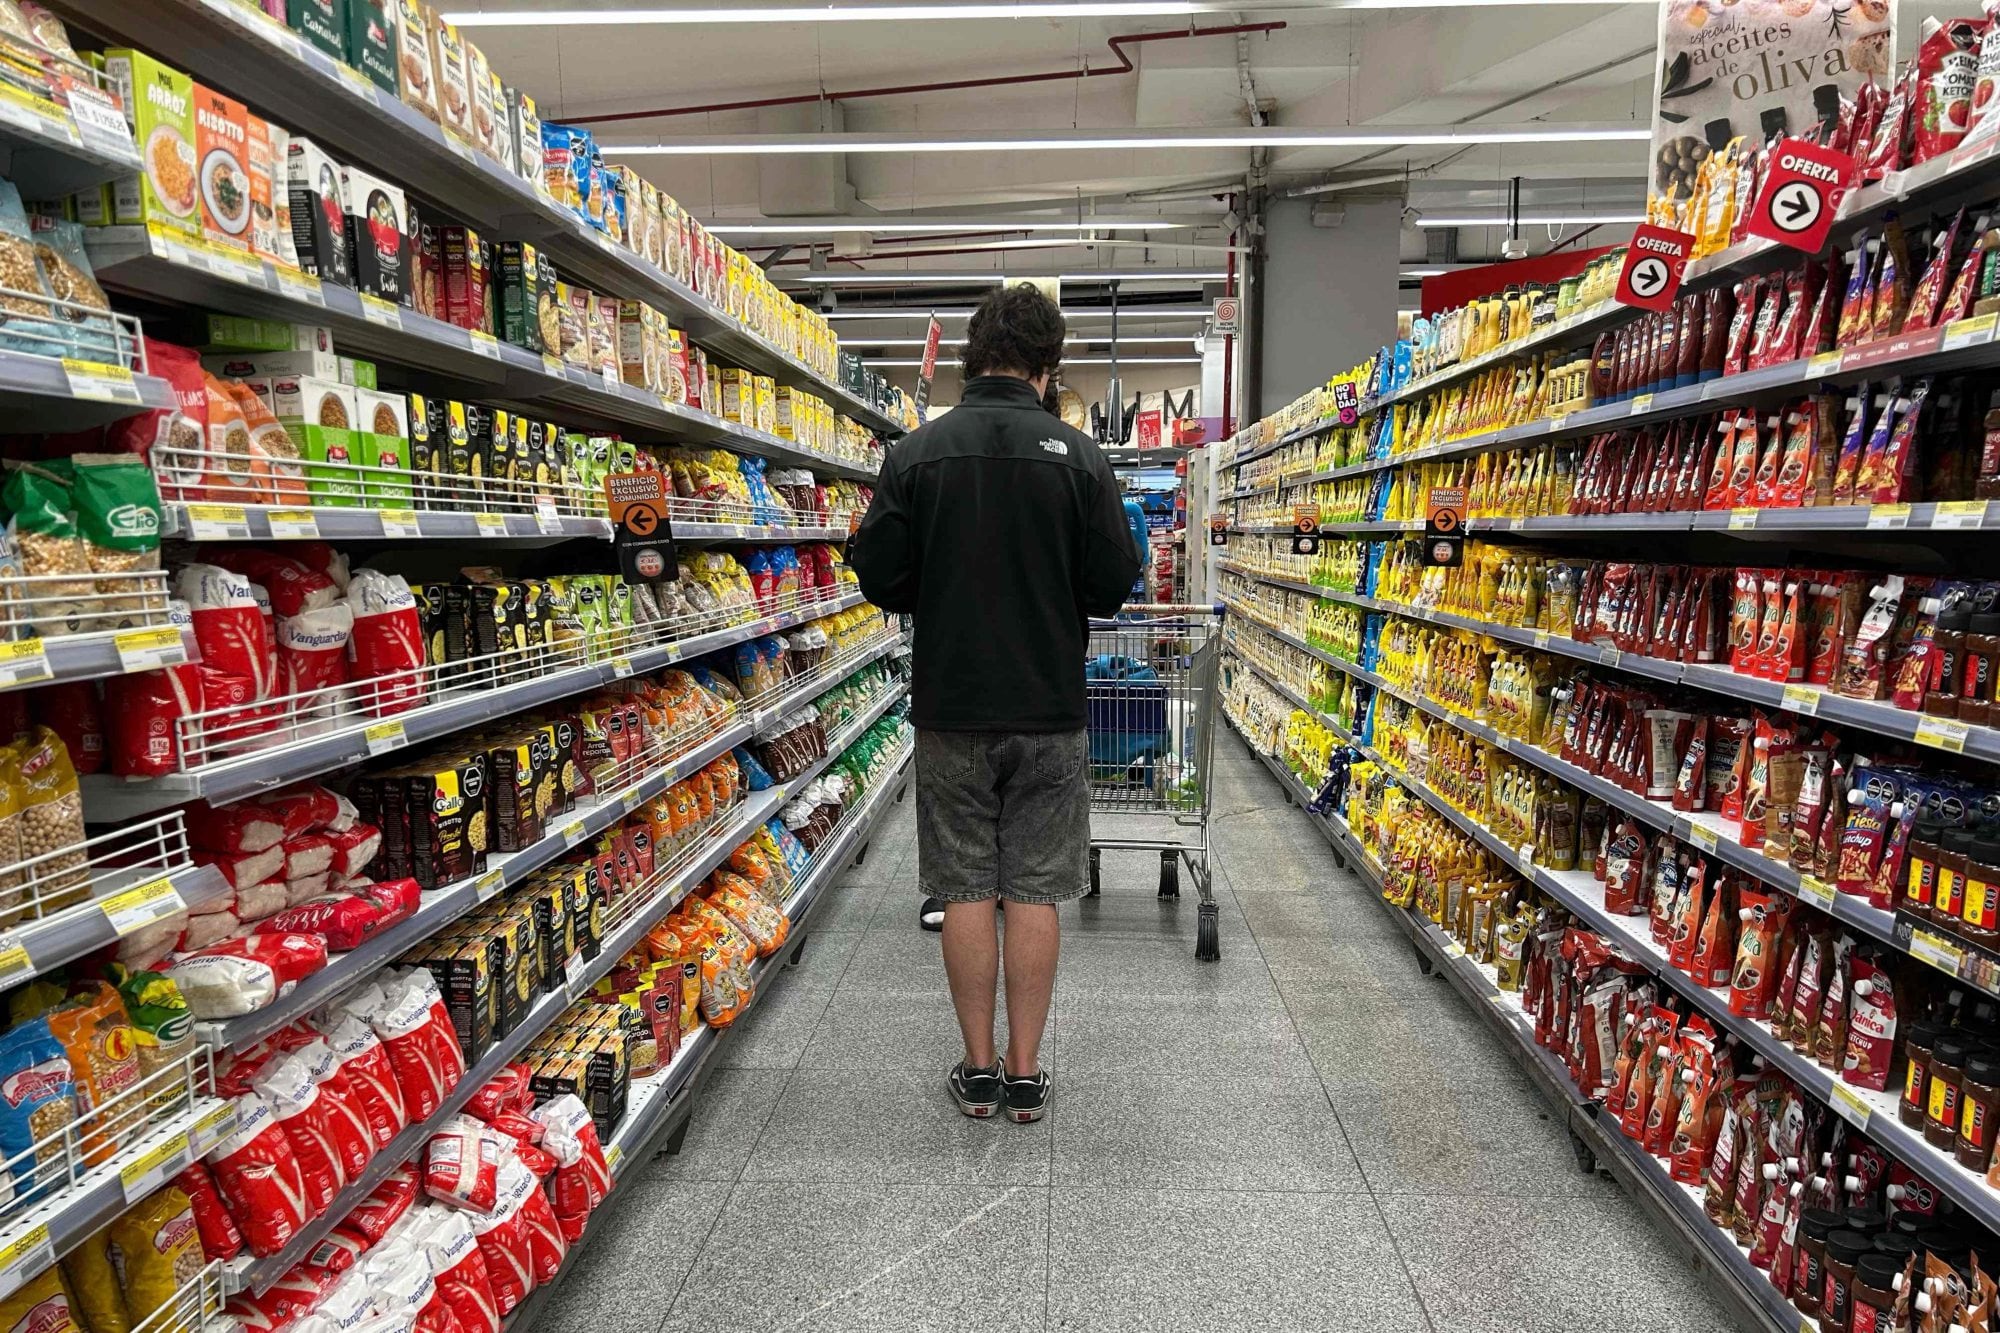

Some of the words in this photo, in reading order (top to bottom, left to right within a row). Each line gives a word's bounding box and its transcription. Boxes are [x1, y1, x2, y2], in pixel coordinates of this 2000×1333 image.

[1689, 16, 1742, 46] especial
[1693, 21, 1792, 67] aceites
[1716, 56, 1739, 79] de
[1732, 43, 1851, 101] oliva
[147, 83, 187, 118] ARROZ
[198, 107, 245, 143] RISOTTO
[1780, 154, 1839, 185] OFERTA
[1636, 234, 1683, 258] OFERTA
[1335, 384, 1350, 393] NO
[1336, 392, 1350, 401] VE
[1338, 399, 1357, 410] DAD
[610, 475, 657, 487] BENEFICIO
[611, 484, 659, 496] EXCLUSIVO
[613, 492, 660, 503] COMUNIDAD
[1431, 489, 1465, 497] BENEFICIO
[1431, 495, 1464, 503] EXCLUSIVO
[289, 630, 348, 648] Vanguardia
[433, 796, 466, 814] Gallo
[437, 817, 463, 830] RISOTTO
[1846, 811, 1882, 832] Fiesta
